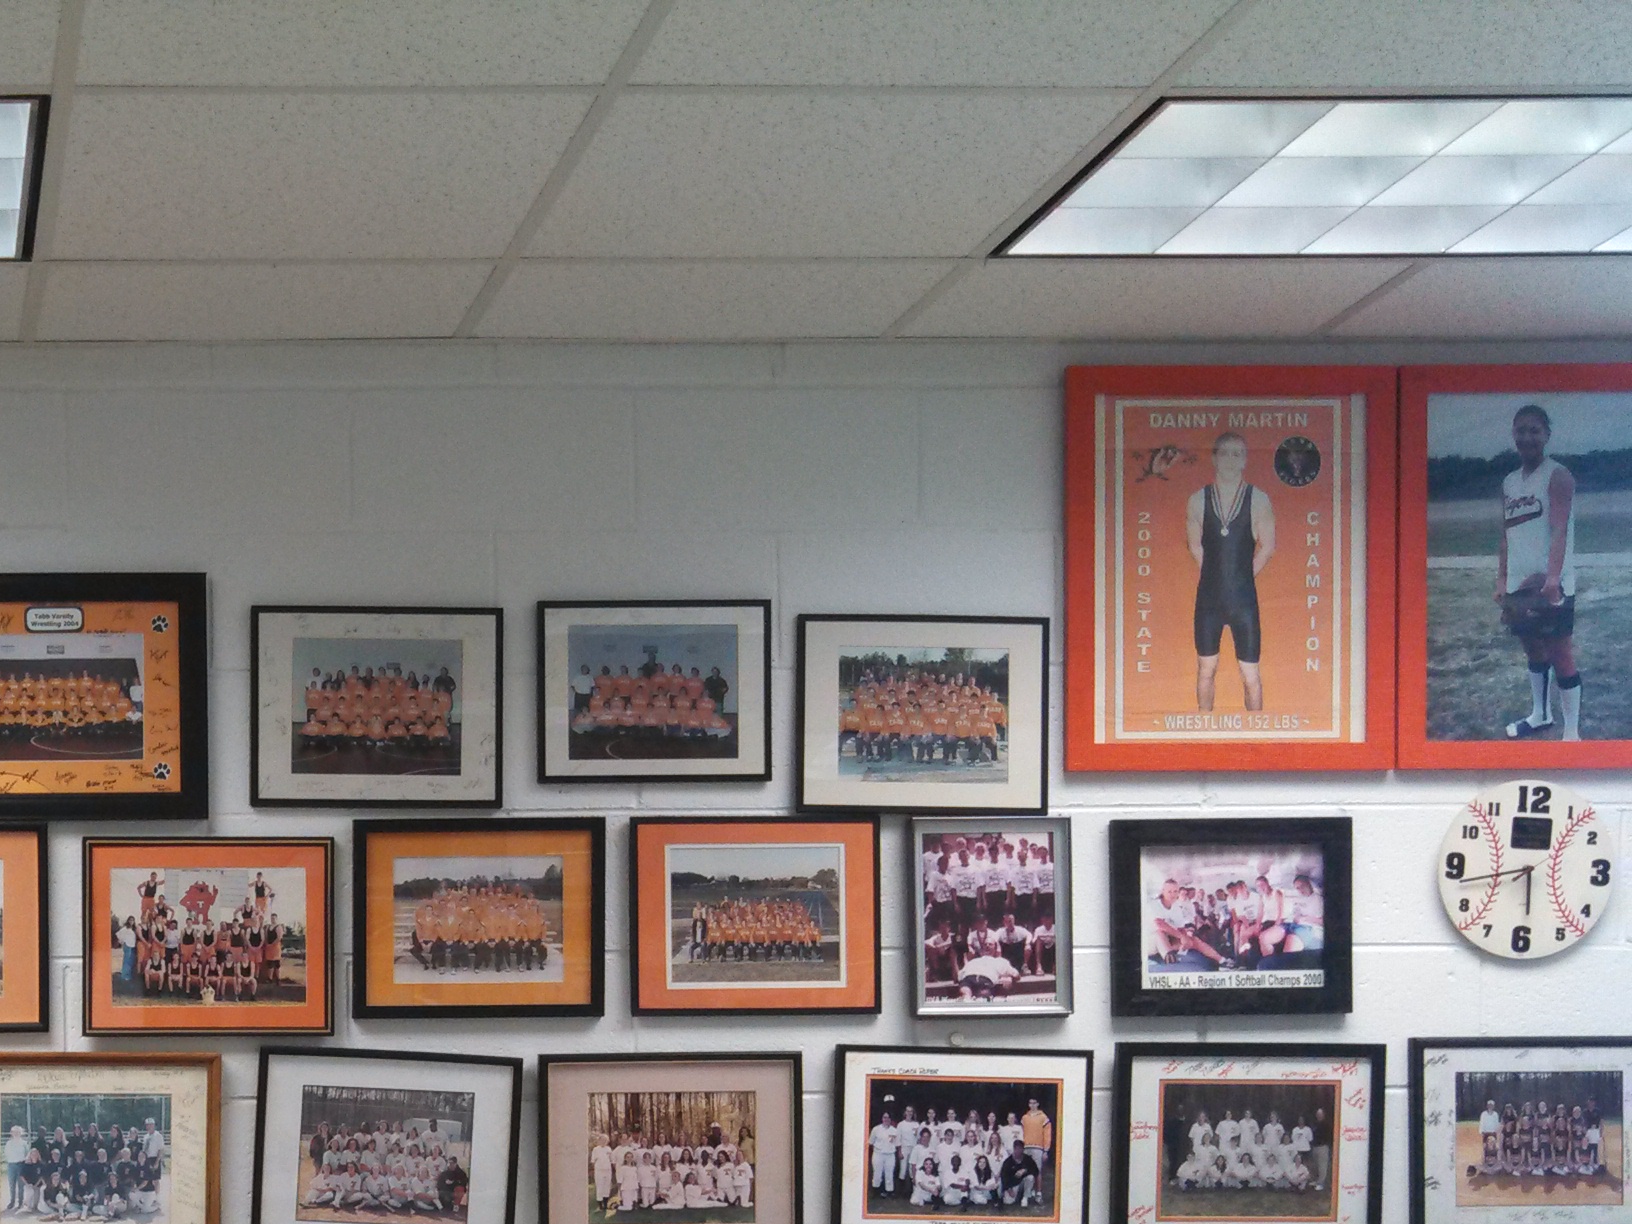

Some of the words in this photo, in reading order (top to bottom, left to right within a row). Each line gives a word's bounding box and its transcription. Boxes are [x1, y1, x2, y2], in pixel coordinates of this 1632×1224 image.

[1149, 412, 1220, 428] DANNY
[1227, 412, 1309, 428] MARTIN
[1136, 511, 1151, 577] 2000
[1305, 511, 1319, 672] CHAMPION
[1136, 591, 1152, 673] STATE
[1164, 715, 1242, 730] WRESTLING
[1246, 714, 1269, 730] 152
[1274, 714, 1299, 729] LBS
[1517, 785, 1552, 814] 12
[1487, 802, 1501, 816] 11
[1568, 806, 1574, 820] 1
[1462, 825, 1479, 840] 10
[1587, 832, 1598, 845] 2
[1445, 852, 1466, 880] 9
[1590, 859, 1611, 887] 3
[1458, 898, 1470, 912] 8
[1580, 904, 1591, 918] 4
[1482, 924, 1493, 938] 7
[1555, 927, 1566, 941] 5
[1511, 926, 1532, 953] 6
[1149, 976, 1172, 988] VHSL
[1179, 976, 1191, 988] AA
[1198, 975, 1226, 989] Region
[1228, 976, 1233, 986] 1
[1235, 974, 1267, 987] Softball
[1268, 974, 1301, 989] Champs
